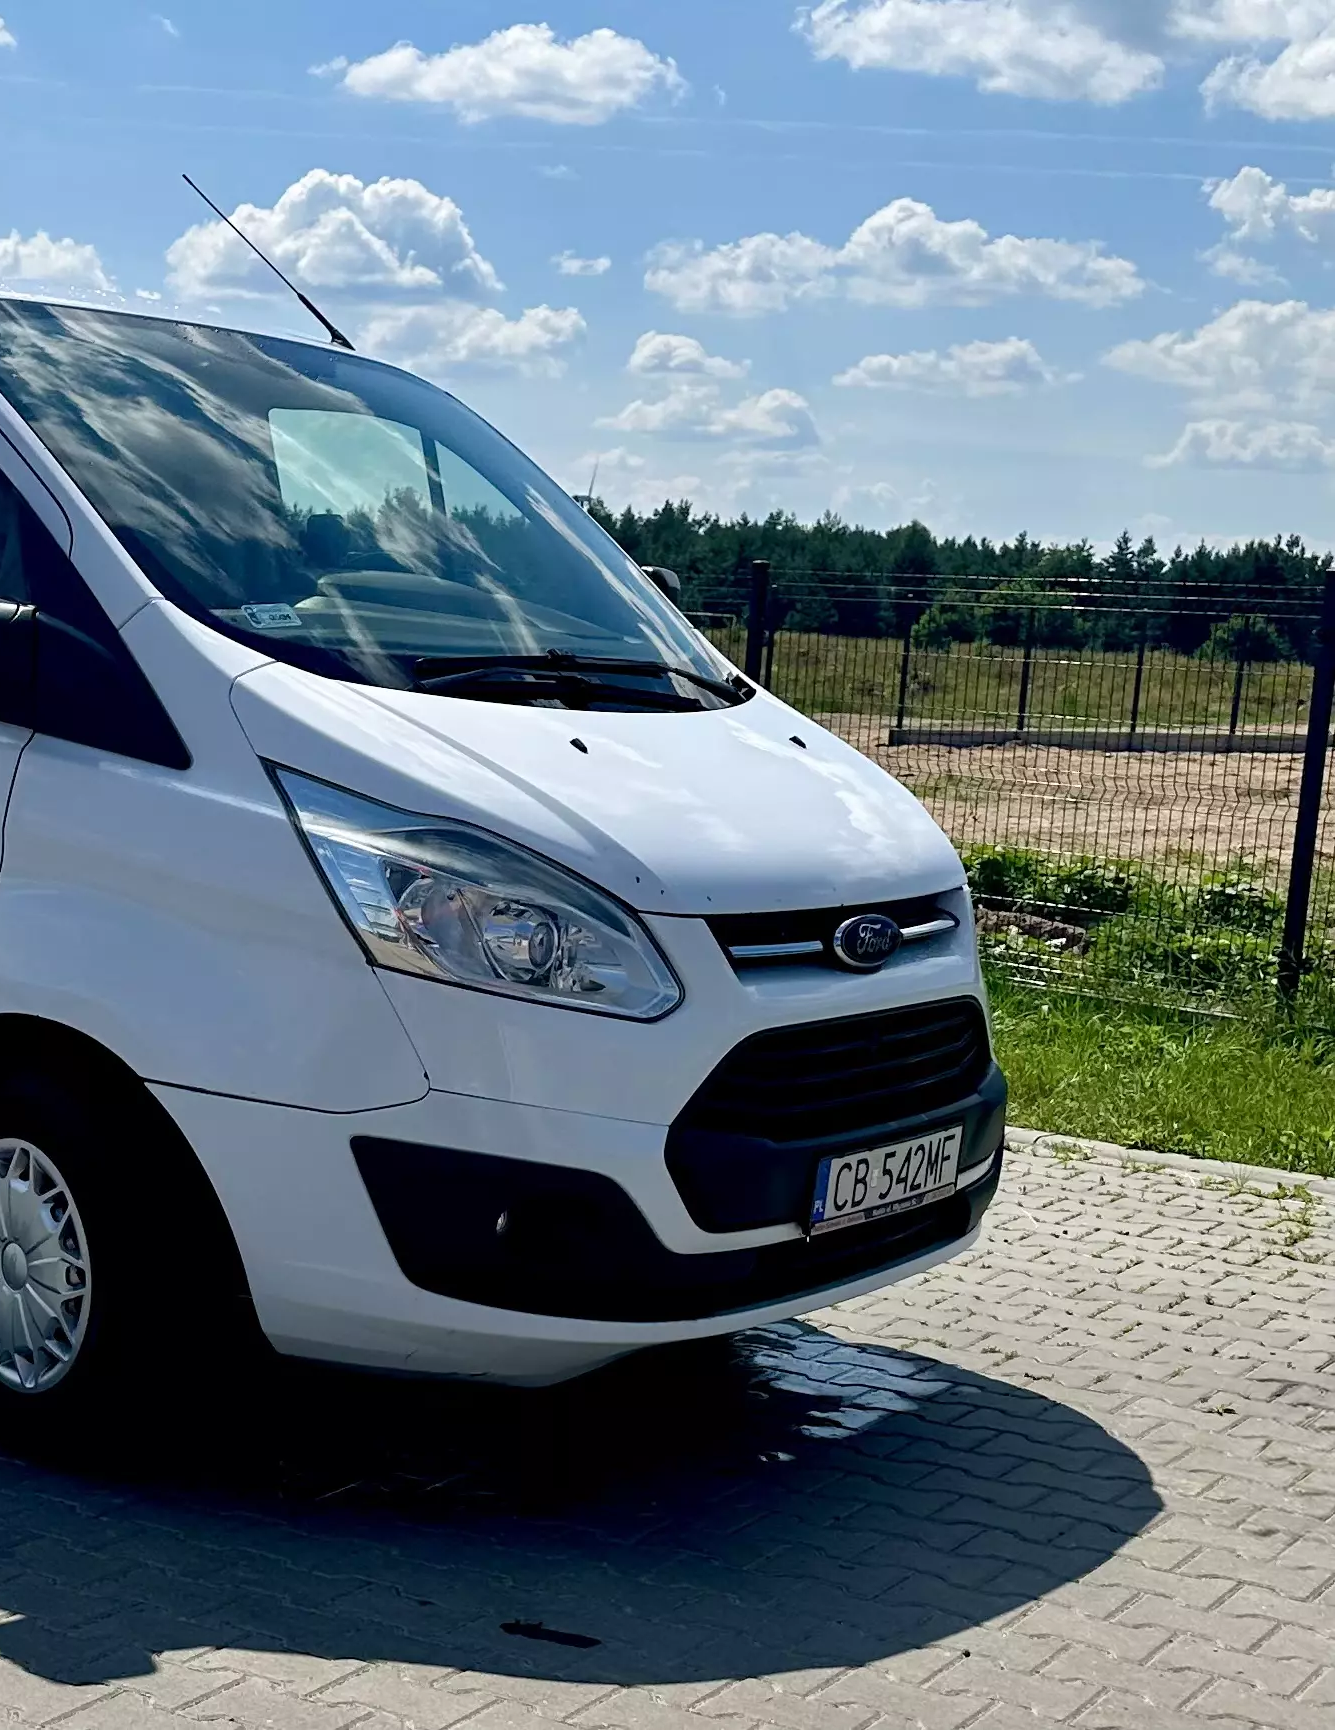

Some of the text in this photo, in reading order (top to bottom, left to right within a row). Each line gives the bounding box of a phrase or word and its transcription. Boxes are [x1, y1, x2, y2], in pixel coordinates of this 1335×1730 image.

[856, 923, 892, 955] Ford
[833, 1134, 956, 1211] CB 542MF
[813, 1200, 824, 1215] PL
